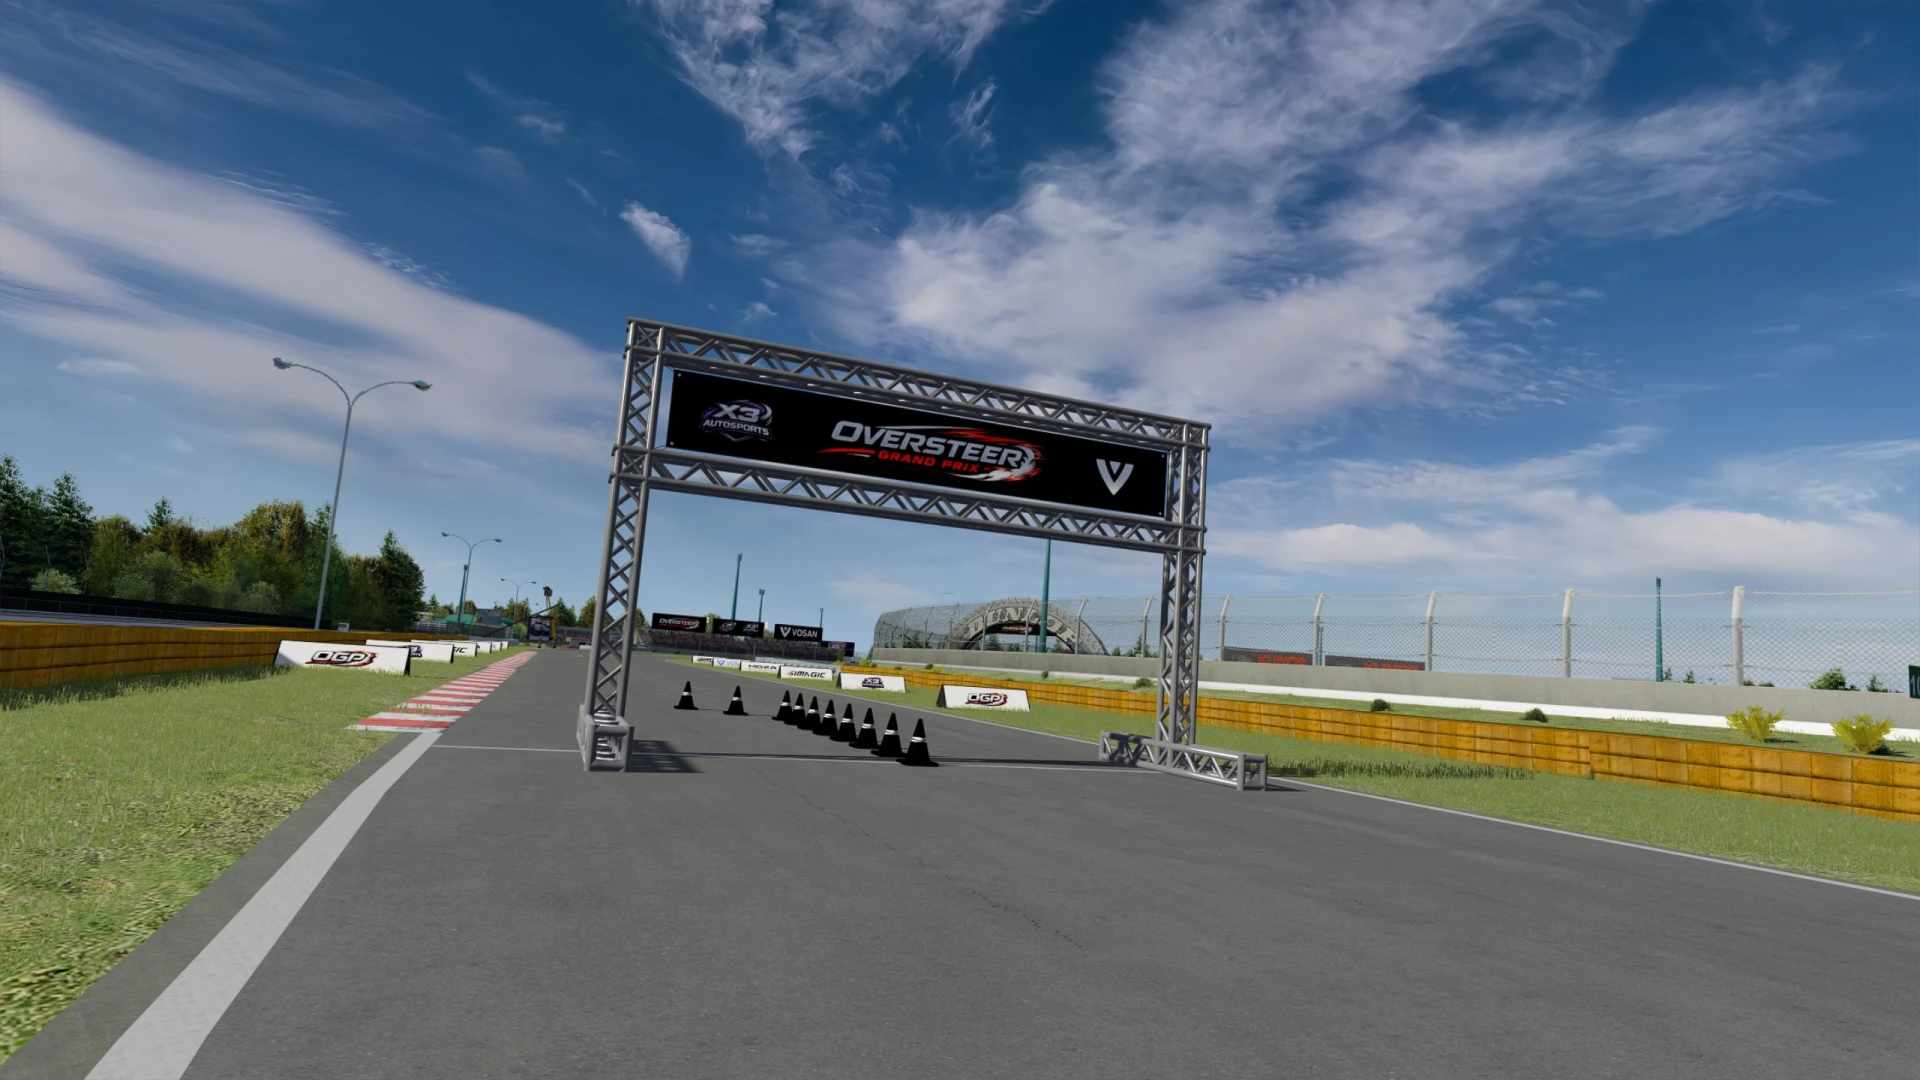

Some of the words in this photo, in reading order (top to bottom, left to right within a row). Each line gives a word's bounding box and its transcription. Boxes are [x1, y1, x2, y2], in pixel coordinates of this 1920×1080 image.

[713, 404, 760, 422] X3
[703, 420, 769, 436] AUTOSPORTS
[831, 420, 1022, 468] OVERSTEER
[878, 450, 936, 467] GRAND
[941, 460, 979, 473] PRIX
[792, 628, 818, 638] VOSAN
[311, 651, 367, 662] OGP
[789, 671, 826, 679] SIMAGIC
[968, 693, 1001, 703] OGP
